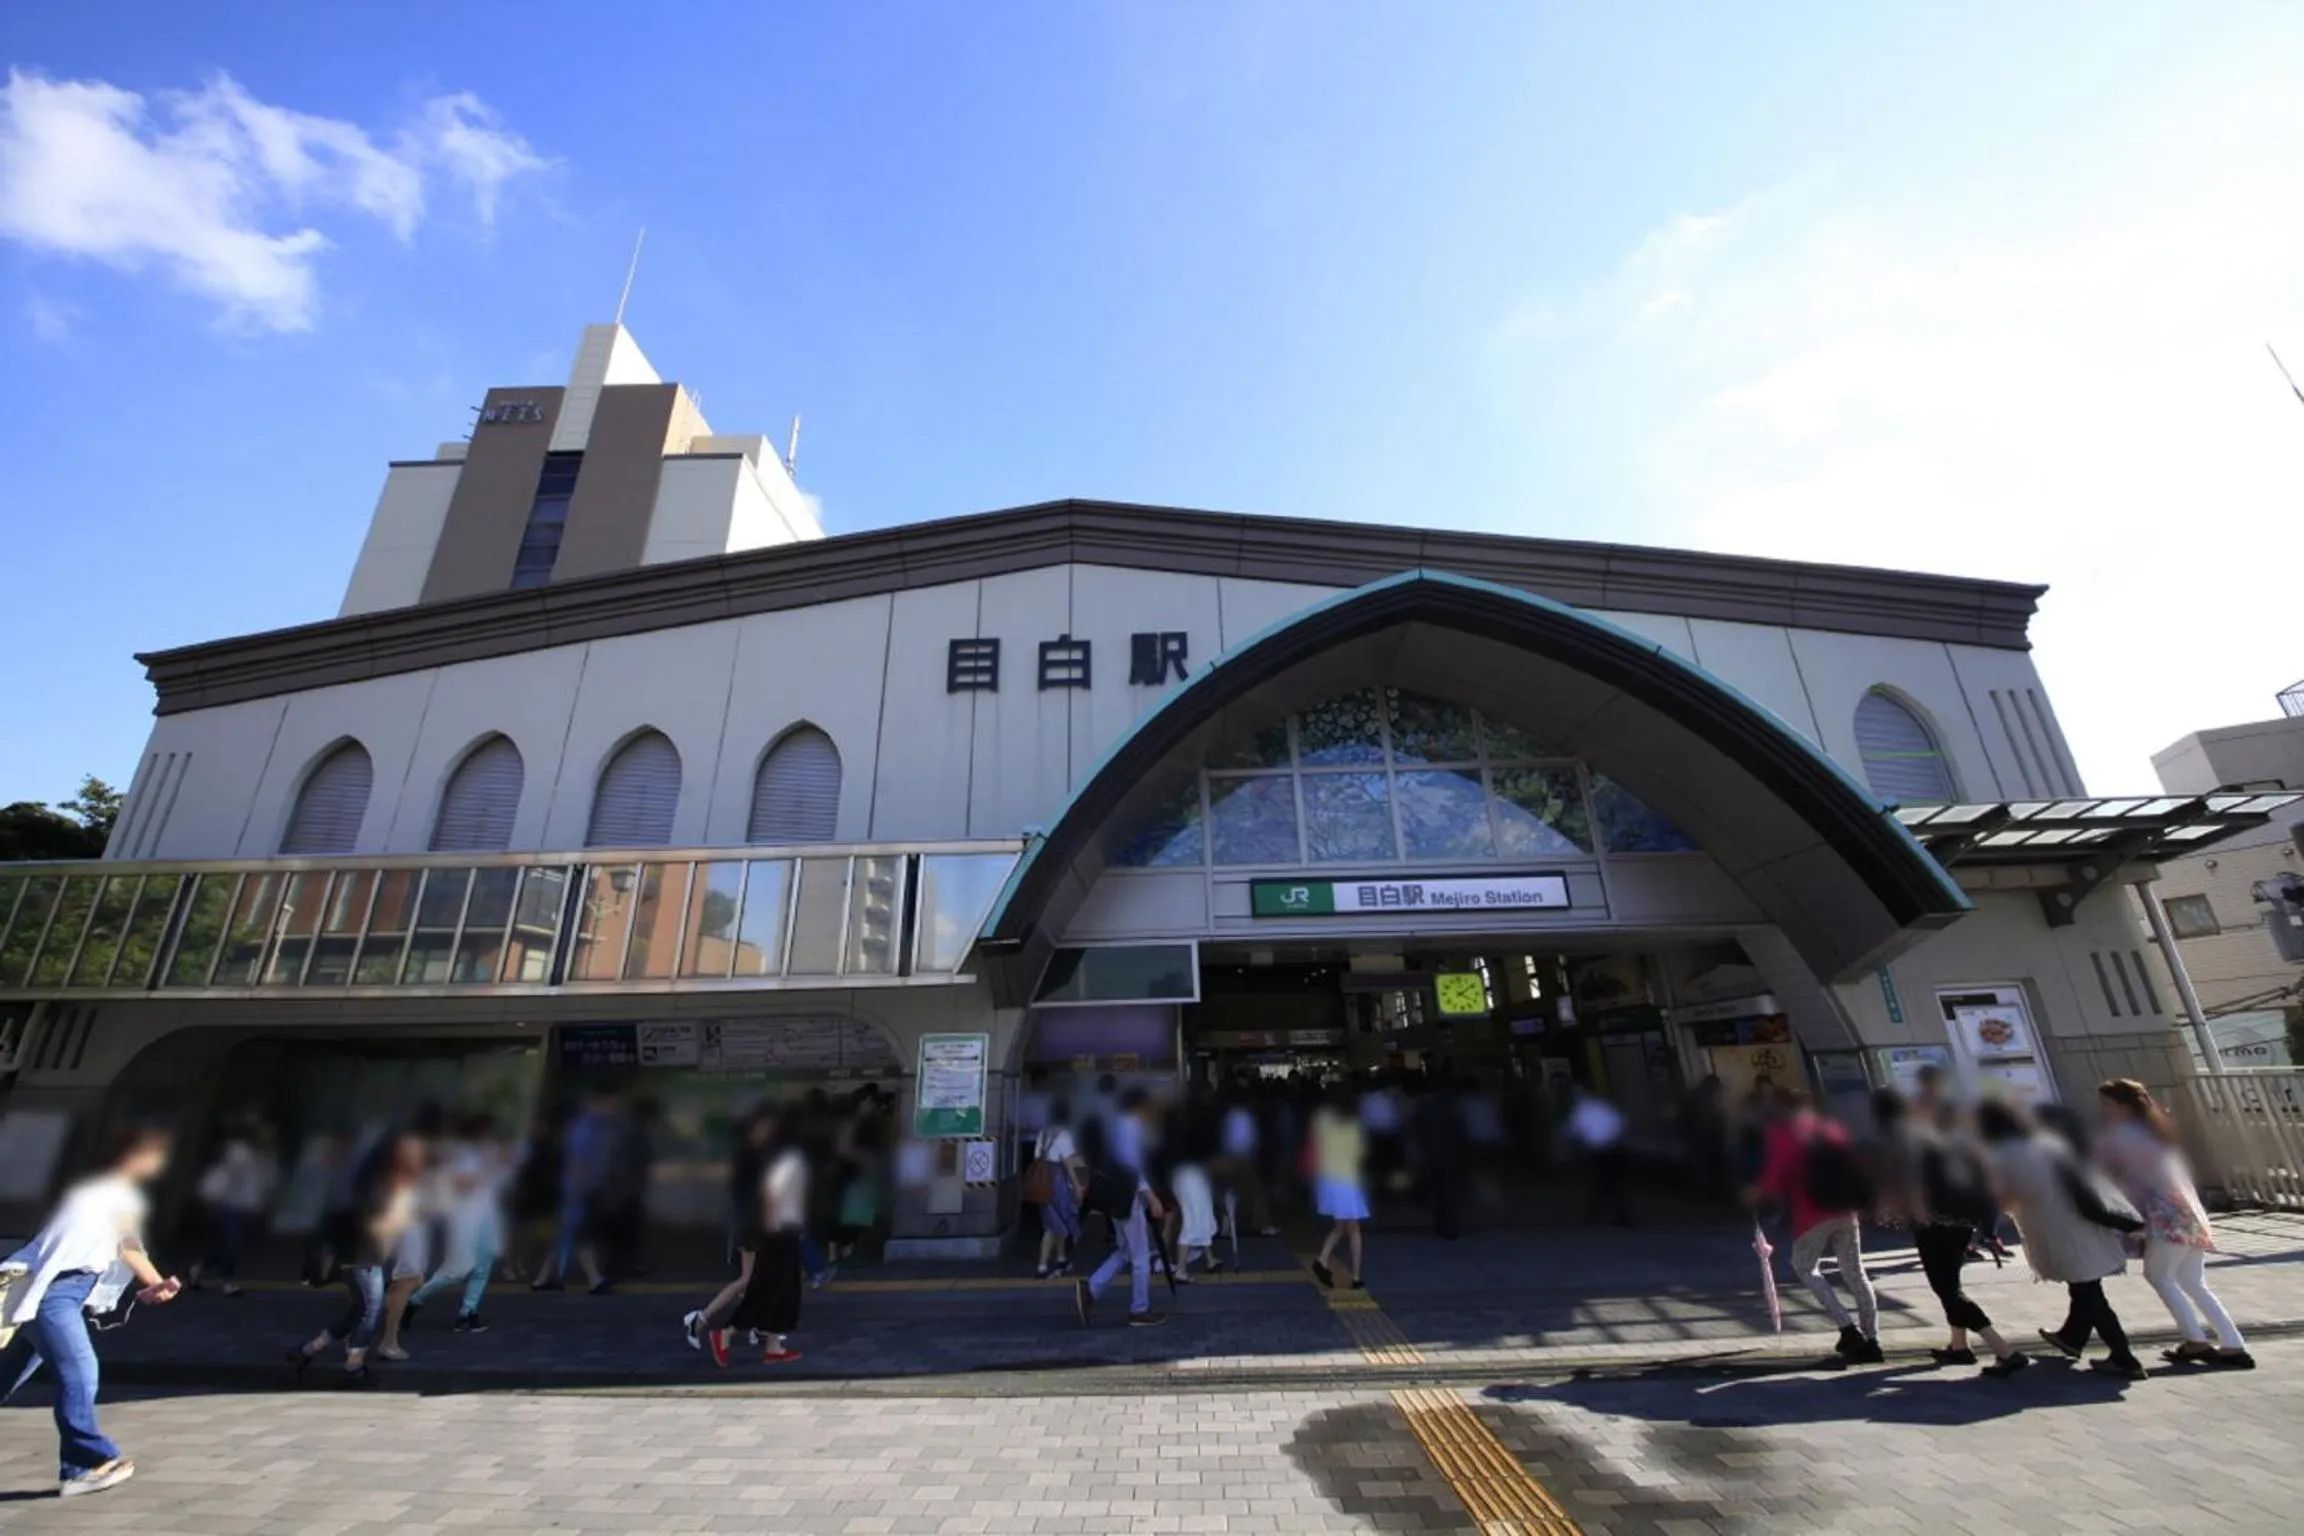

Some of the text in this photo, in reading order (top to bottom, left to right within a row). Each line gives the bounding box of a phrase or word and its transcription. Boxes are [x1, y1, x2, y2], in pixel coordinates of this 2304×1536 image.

[947, 632, 1189, 694] 目白駅
[1279, 887, 1310, 903] JR
[1357, 885, 1544, 908] 目白駅 Mejiro Station
